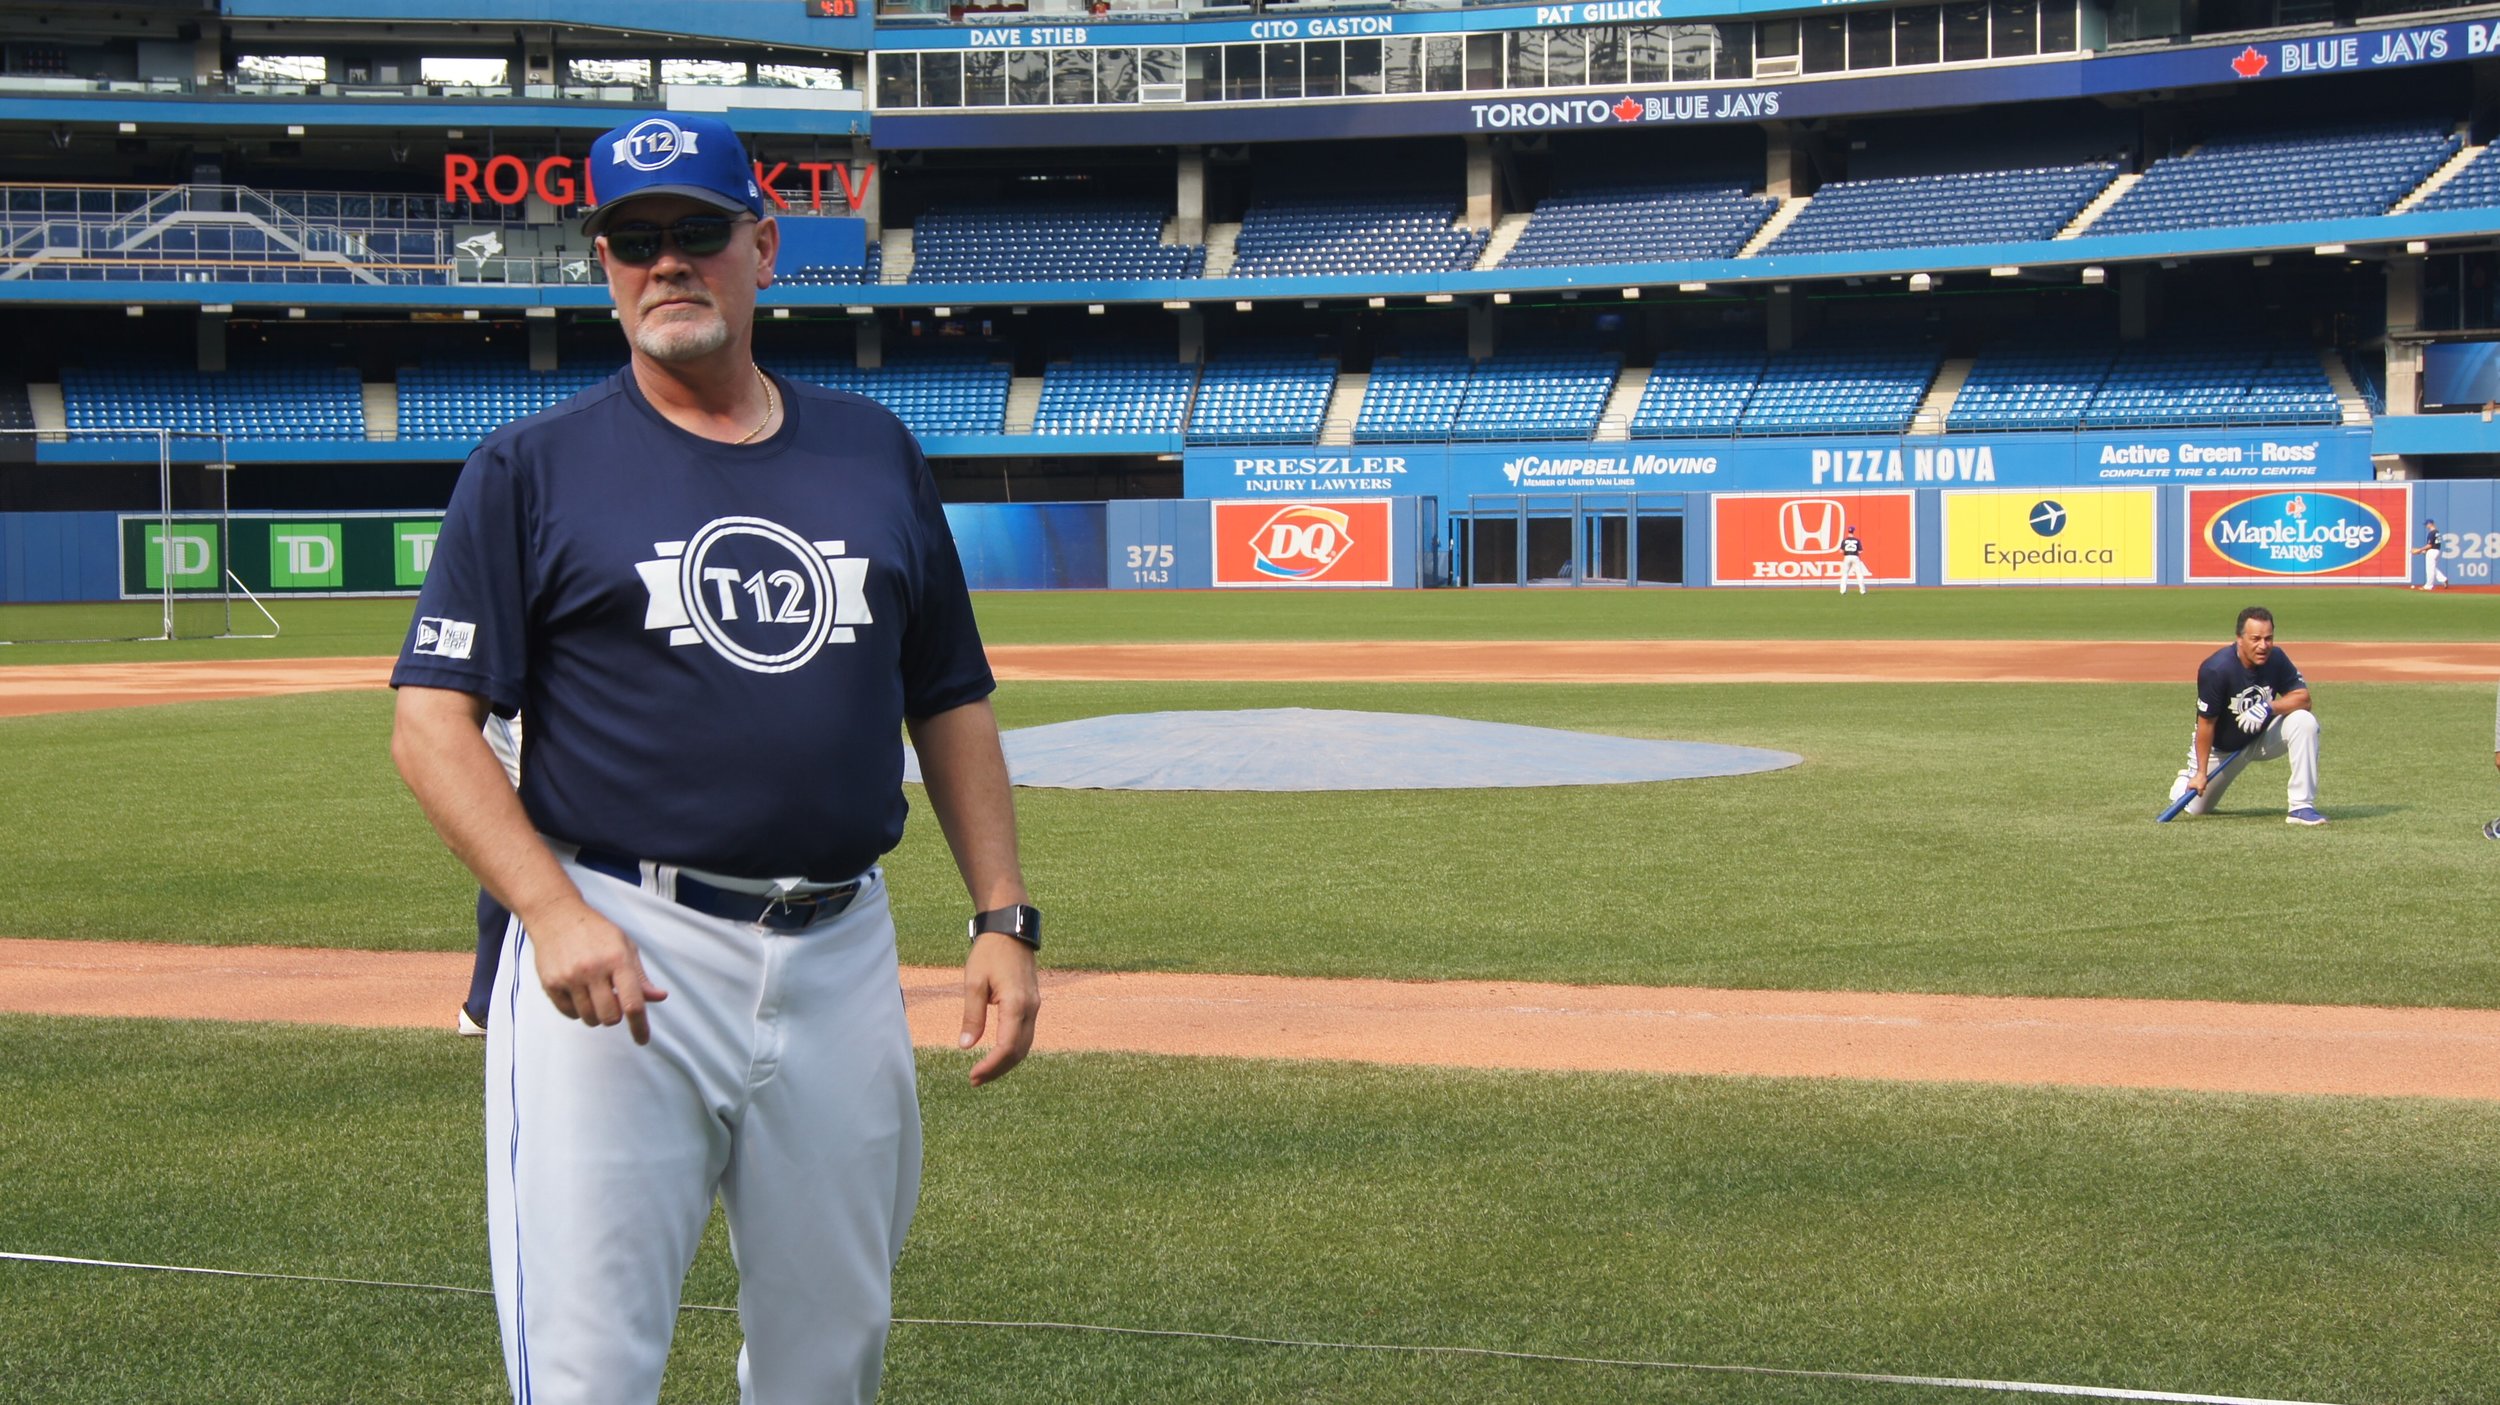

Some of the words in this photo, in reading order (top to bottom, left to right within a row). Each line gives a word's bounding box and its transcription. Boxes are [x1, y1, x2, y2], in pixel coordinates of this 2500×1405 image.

[1536, 6, 1573, 25] PAT
[1582, 0, 1662, 22] GILLICK
[970, 28, 1021, 46] DAVE
[1031, 27, 1088, 45] STIEB
[1250, 20, 1298, 39] CITO
[1308, 16, 1393, 36] GASTON
[2281, 38, 2359, 73] BLUE
[2371, 29, 2448, 64] JAYS
[1471, 99, 1610, 128] TORONTO
[1645, 95, 1709, 121] BLUE
[1715, 91, 1780, 118] JAYS
[630, 131, 674, 156] T12
[445, 154, 598, 206] ROG
[1523, 456, 1630, 476] CAMPBELL
[1632, 455, 1718, 474] MOVING
[1812, 449, 1904, 484] PIZZA
[1914, 446, 1996, 481] NOVA
[2100, 444, 2170, 464] Active
[1234, 457, 1408, 476] PRESZLER
[2099, 468, 2171, 477] COMPLETE
[2174, 468, 2202, 477] TIRE
[2206, 467, 2216, 476] &
[2220, 467, 2259, 476] AUTO
[2261, 466, 2317, 475] CENTRE
[1246, 479, 1306, 492] INJURY
[1311, 478, 1393, 490] LAWYERS
[1523, 478, 1555, 487] MEMBER
[1567, 478, 1595, 487] UNITED
[1595, 477, 1612, 486] VAN
[1613, 477, 1636, 486] LINES
[152, 536, 210, 574] TD
[276, 535, 335, 574] TD
[1268, 523, 1336, 564] DQ
[2270, 545, 2323, 562] FARMS
[2441, 532, 2500, 559] 328
[1126, 545, 1174, 568] 375
[1984, 543, 2113, 571] Expedia.ca
[1133, 571, 1168, 583] 114.3
[2457, 562, 2488, 577] 100
[703, 567, 810, 624] T12
[443, 639, 467, 650] ERA
[445, 628, 469, 641] NEW
